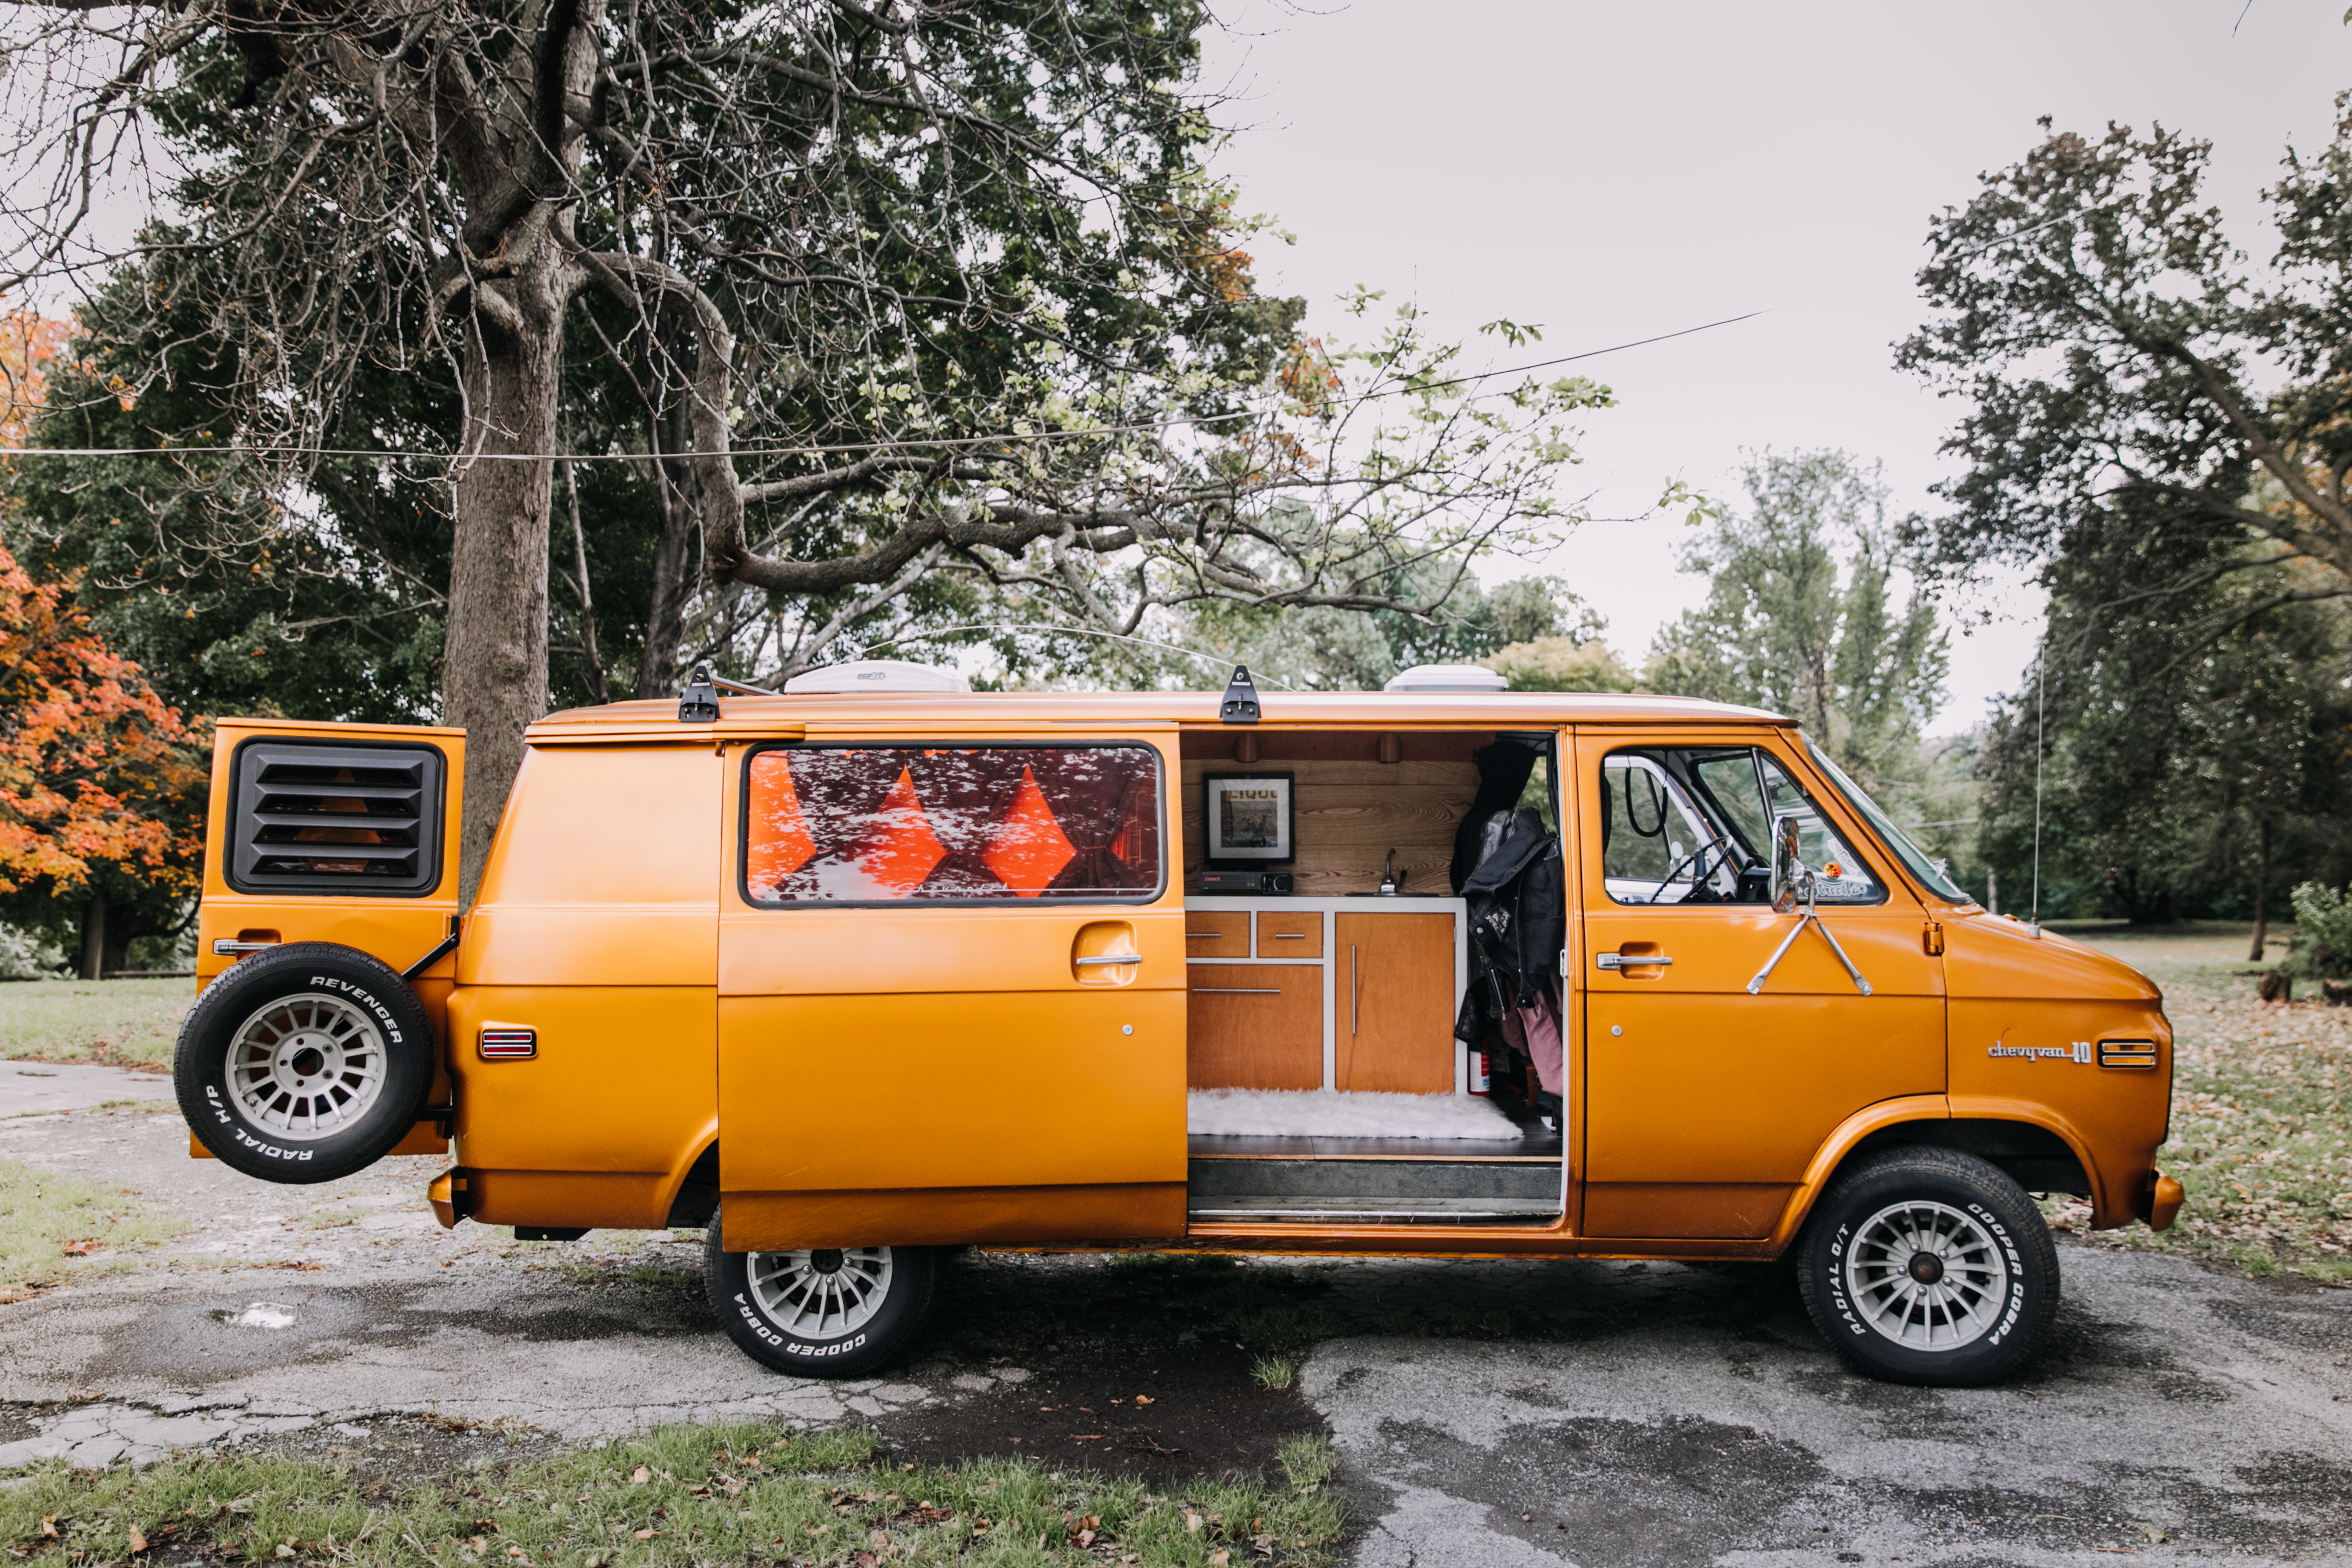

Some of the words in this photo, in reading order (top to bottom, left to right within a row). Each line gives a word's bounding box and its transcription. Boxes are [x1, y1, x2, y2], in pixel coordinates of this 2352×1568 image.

[894, 882, 1008, 893] Chevrolet
[310, 976, 402, 1043] REVENGER
[206, 1085, 231, 1124] H/P
[235, 1128, 314, 1161] RADIAL
[1831, 1223, 1848, 1257] G/T
[1968, 1203, 2023, 1275] COOPER
[734, 1293, 783, 1346] COBRA
[1829, 1263, 1866, 1335] RADIAL
[1988, 1282, 2024, 1346] COBRA
[786, 1333, 866, 1357] COOPER
